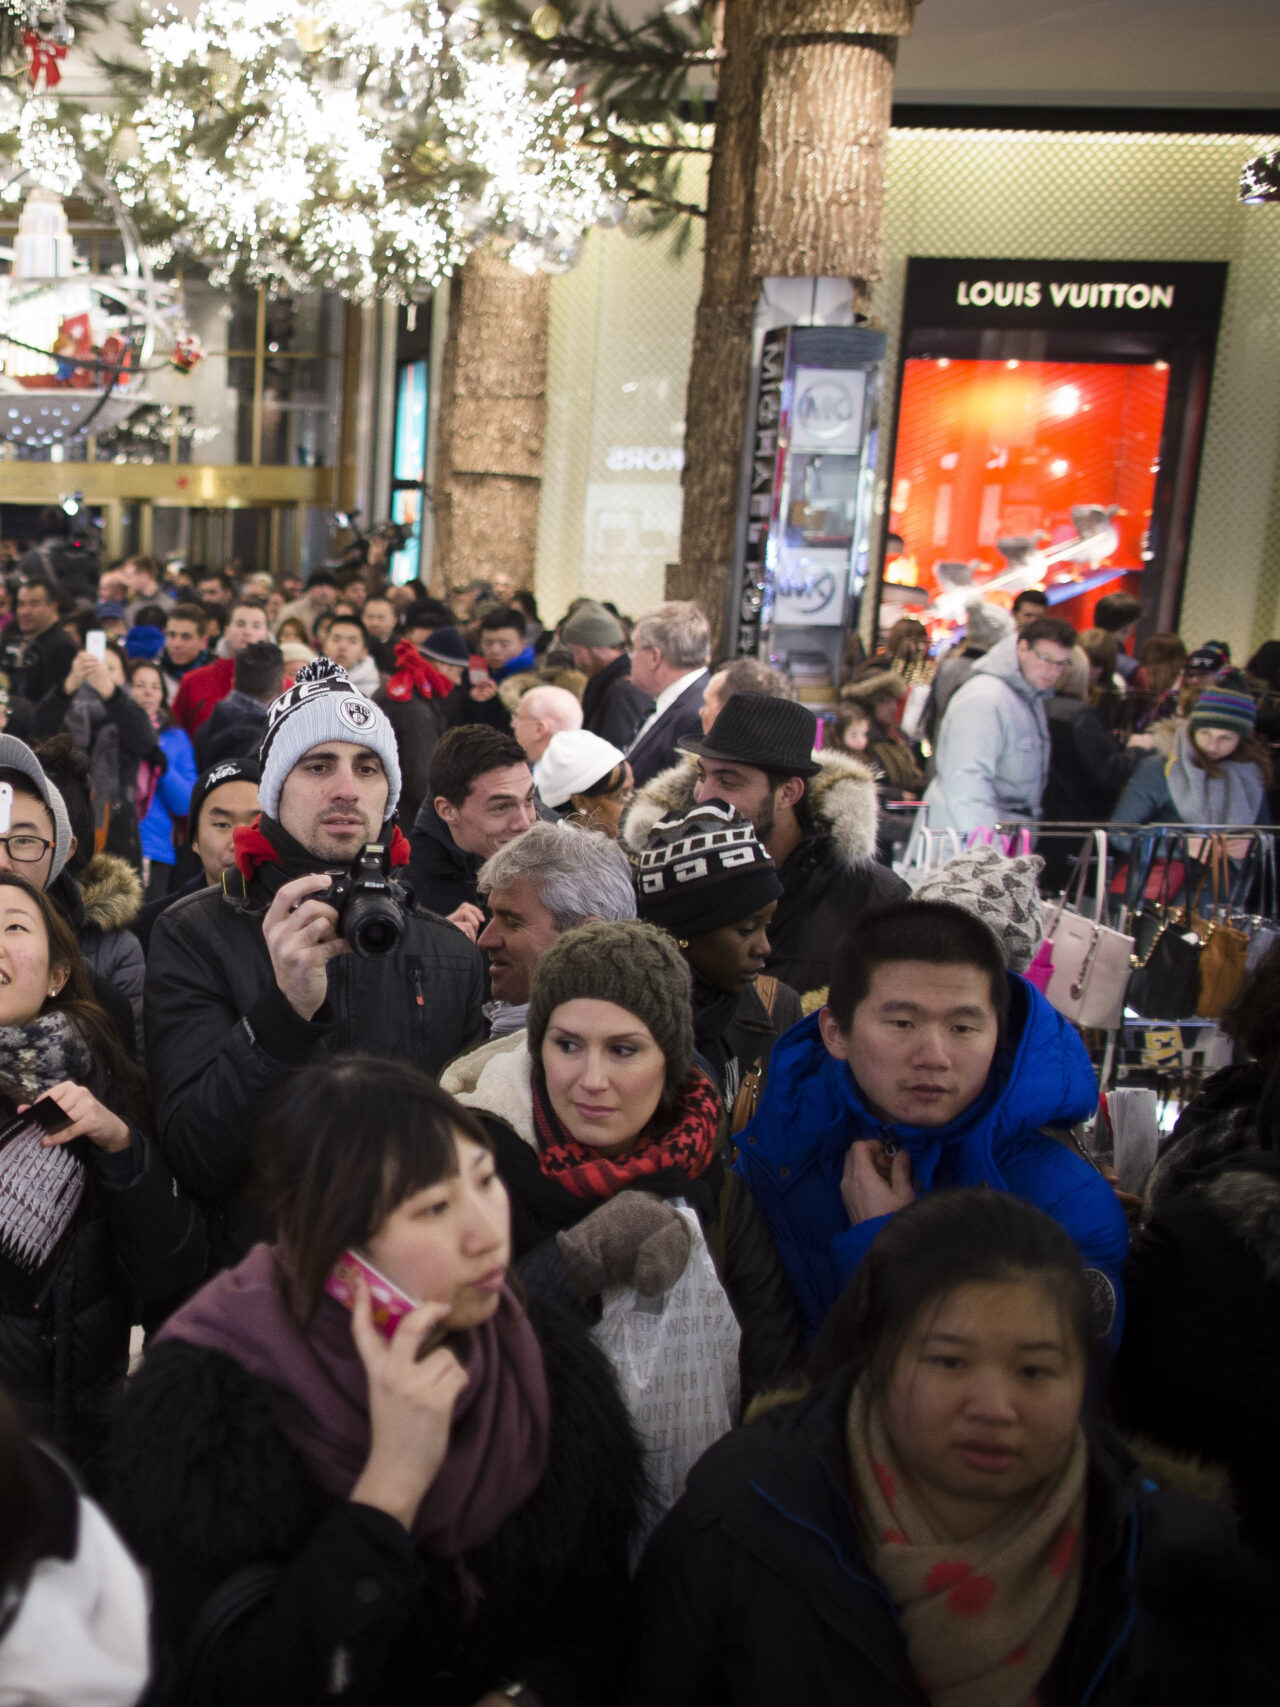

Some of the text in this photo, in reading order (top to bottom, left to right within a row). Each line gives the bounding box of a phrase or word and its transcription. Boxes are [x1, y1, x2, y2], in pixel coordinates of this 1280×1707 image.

[956, 280, 1175, 310] LOUIS VUITTON
[748, 342, 782, 545] MICHAEL
[345, 703, 370, 717] NETS
[363, 880, 386, 890] Nikon
